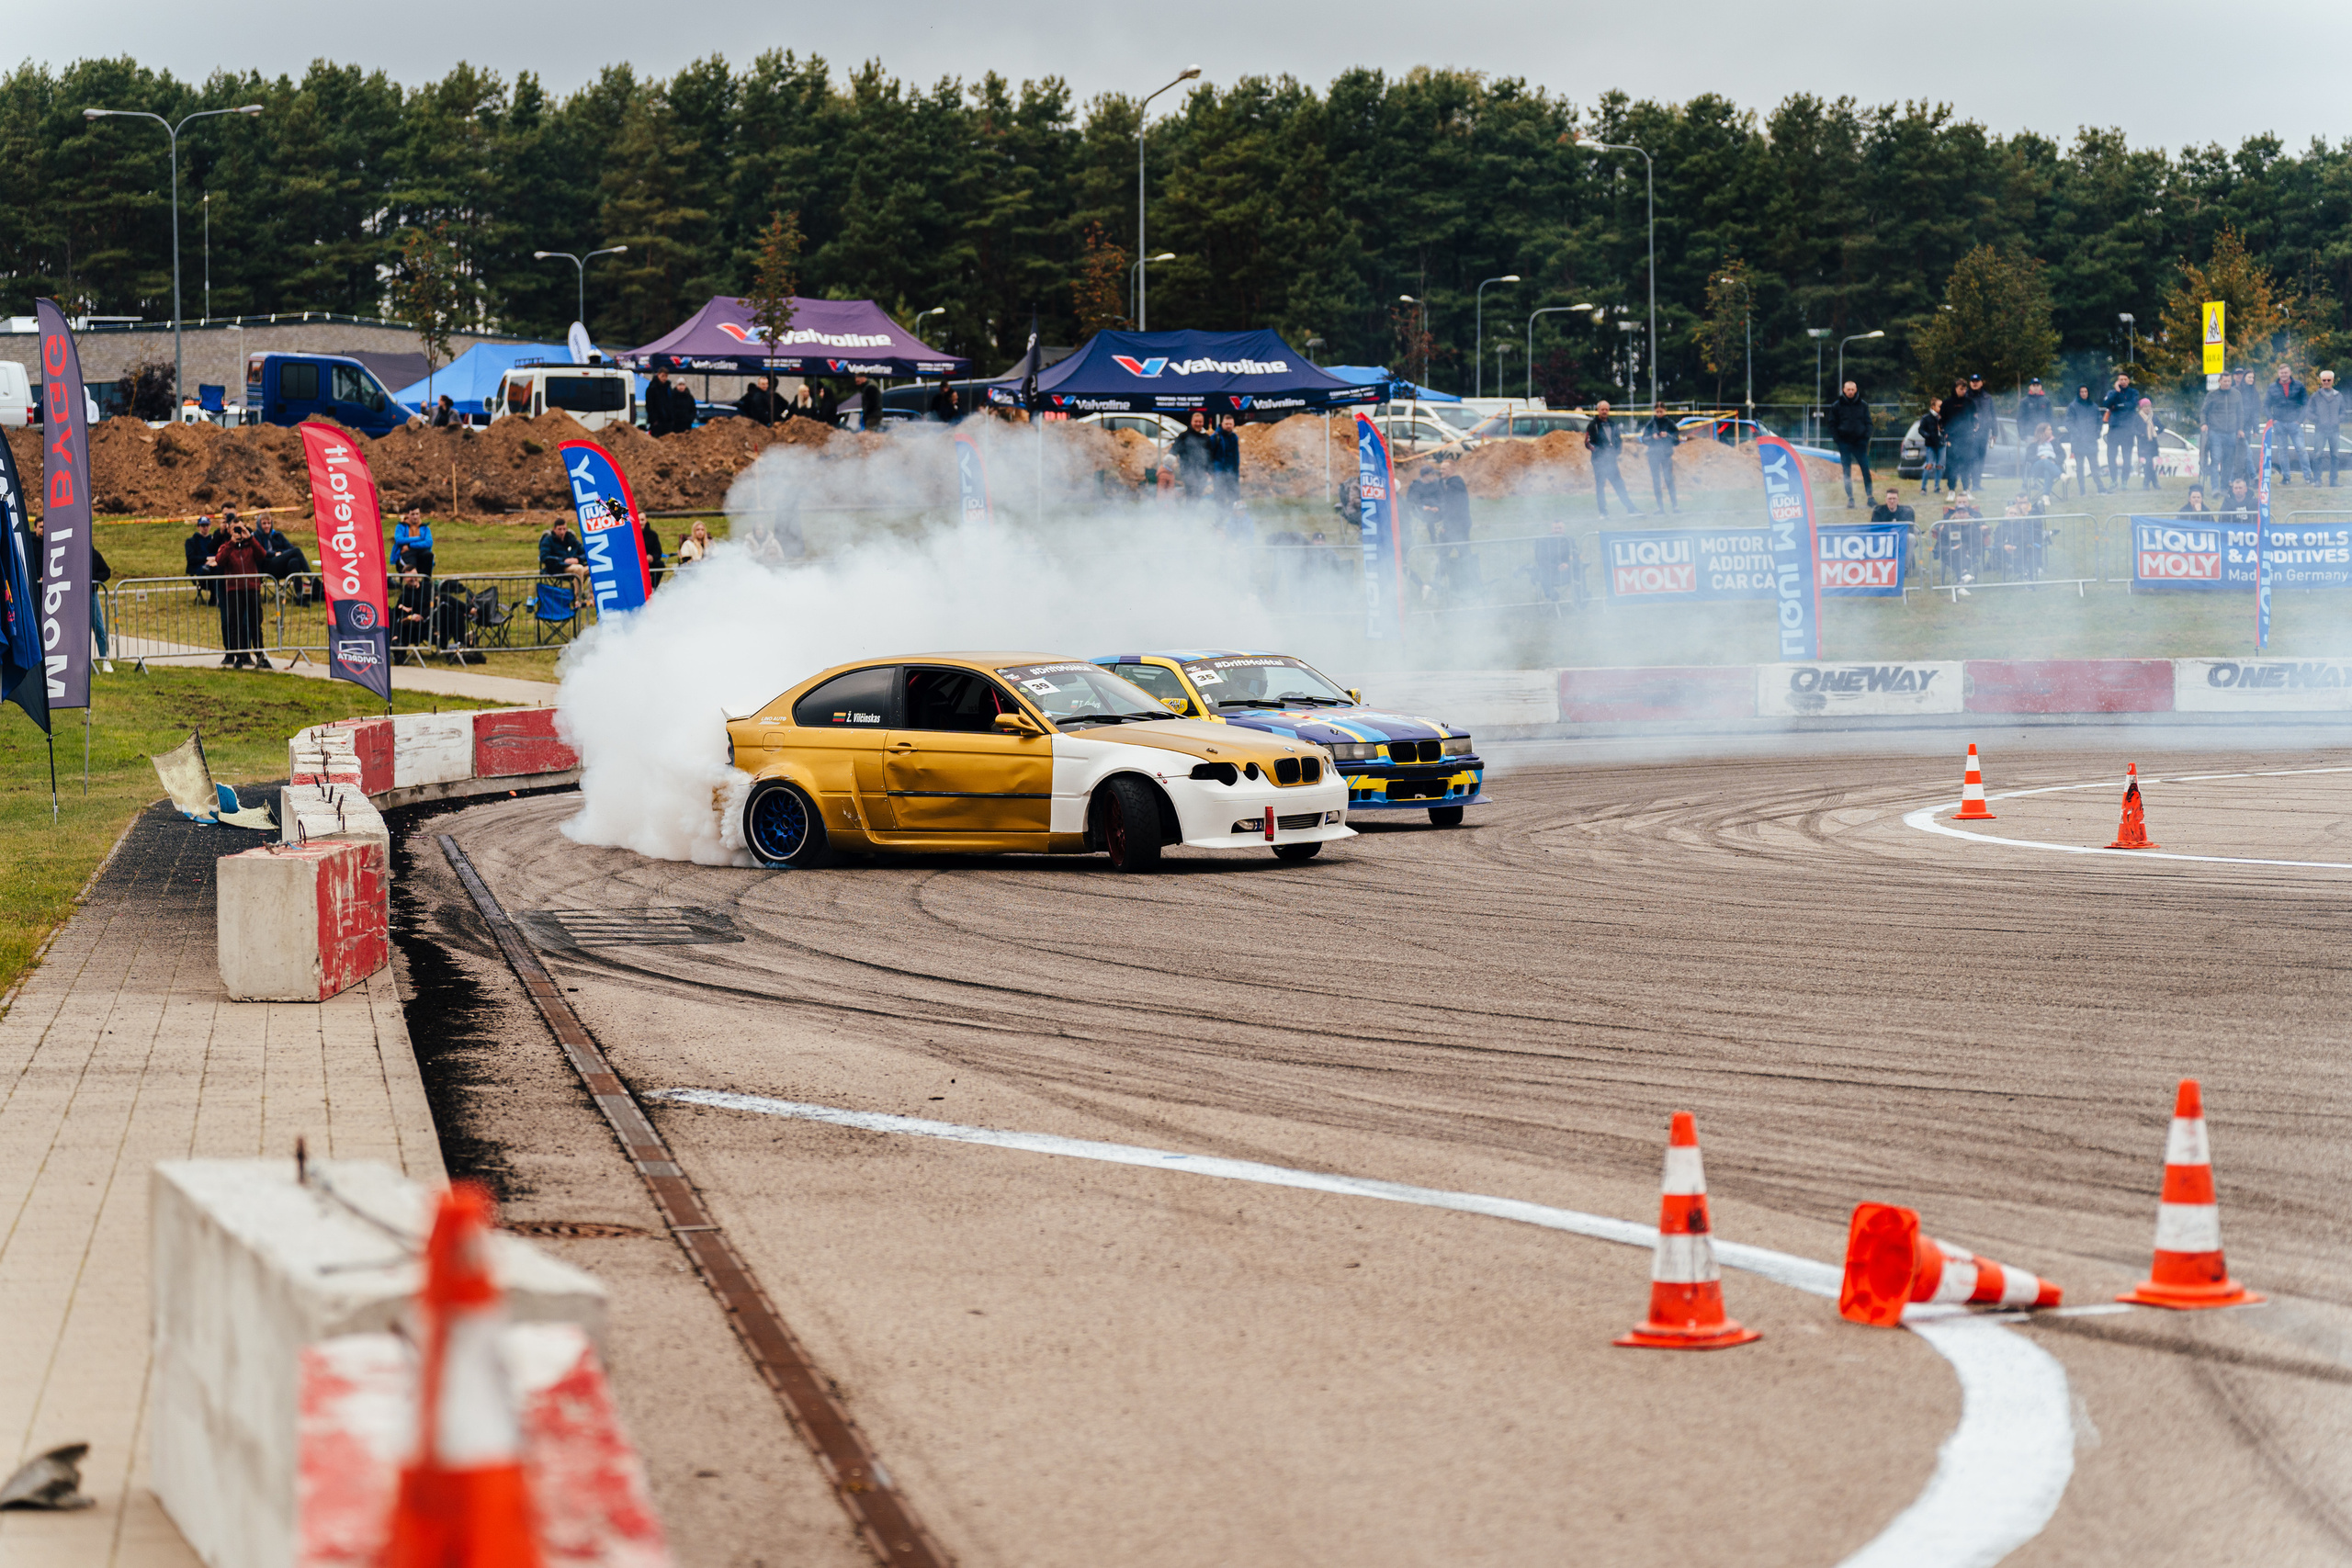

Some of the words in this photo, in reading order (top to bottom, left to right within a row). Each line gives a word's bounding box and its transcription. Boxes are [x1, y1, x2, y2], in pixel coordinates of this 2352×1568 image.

[777, 327, 892, 347] Valvoline
[1168, 356, 1288, 376] Valvoline
[1075, 399, 1131, 411] Valvoline
[1701, 536, 1764, 554] MOTOR
[1820, 535, 1894, 560] LIQUI
[2143, 528, 2216, 552] LIQUI
[2227, 530, 2299, 547] MOOR
[2303, 530, 2349, 546] OILS
[1614, 537, 1690, 566] LIQUI
[2227, 548, 2244, 563] &
[2245, 547, 2350, 564] ADITIVES
[1708, 554, 1775, 572] ADDITI
[2143, 553, 2219, 577] MOLY
[1617, 565, 1694, 592] MOLY
[1712, 573, 1748, 590] CAR
[1752, 572, 1777, 590] CA
[1821, 560, 1895, 586] MOLY
[2228, 568, 2257, 581] Mad
[2270, 569, 2282, 581] in
[2286, 568, 2349, 582] Germany
[1031, 682, 1050, 691] 39
[1197, 673, 1215, 682] 35
